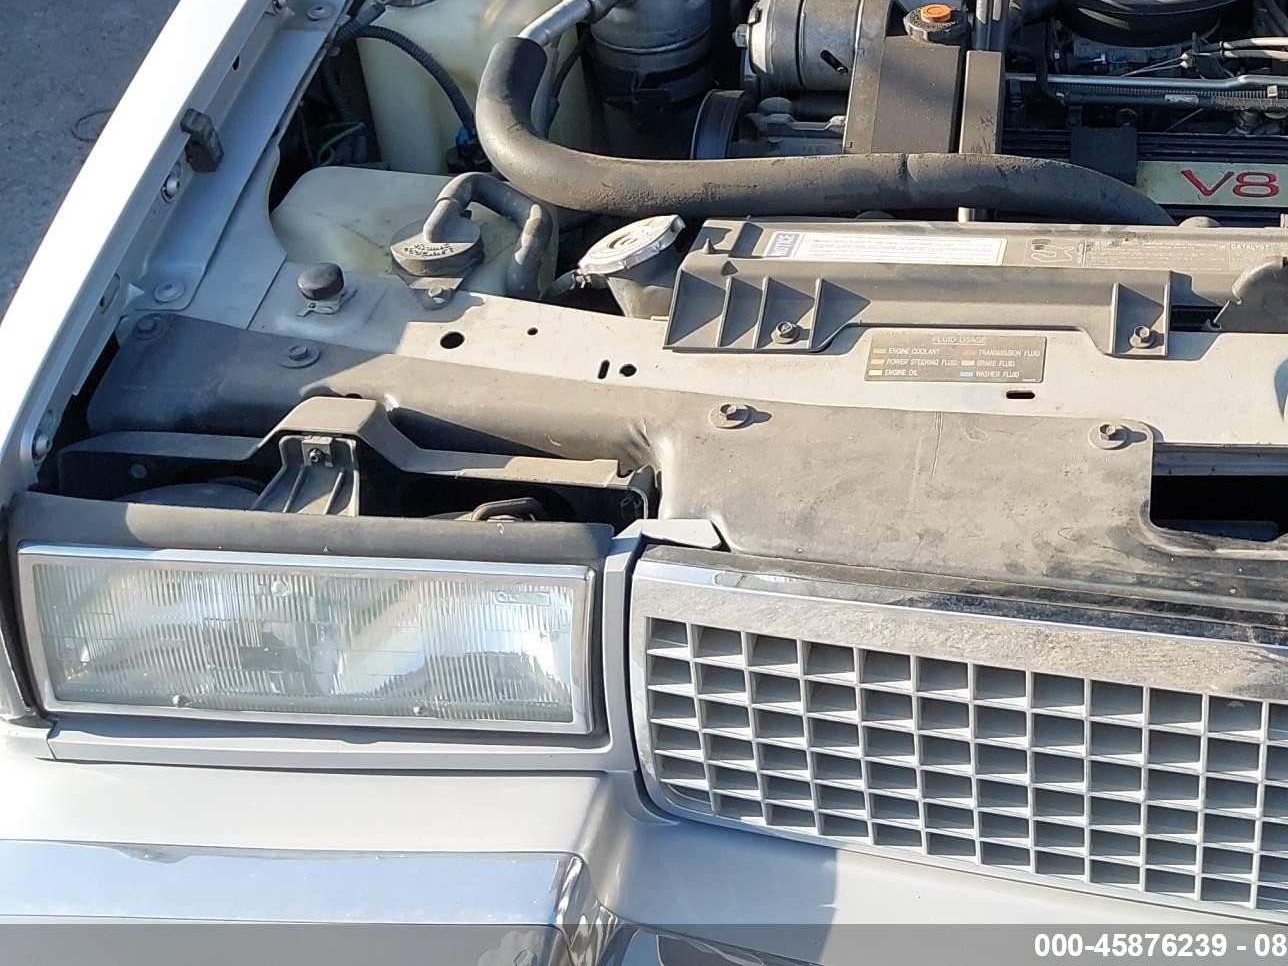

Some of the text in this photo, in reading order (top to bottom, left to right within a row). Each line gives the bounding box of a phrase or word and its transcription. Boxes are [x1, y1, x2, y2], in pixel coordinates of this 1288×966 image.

[1180, 168, 1280, 199] V8
[1024, 350, 1041, 358] FLUID
[886, 358, 909, 366] POWER
[975, 370, 1001, 378] WASHER
